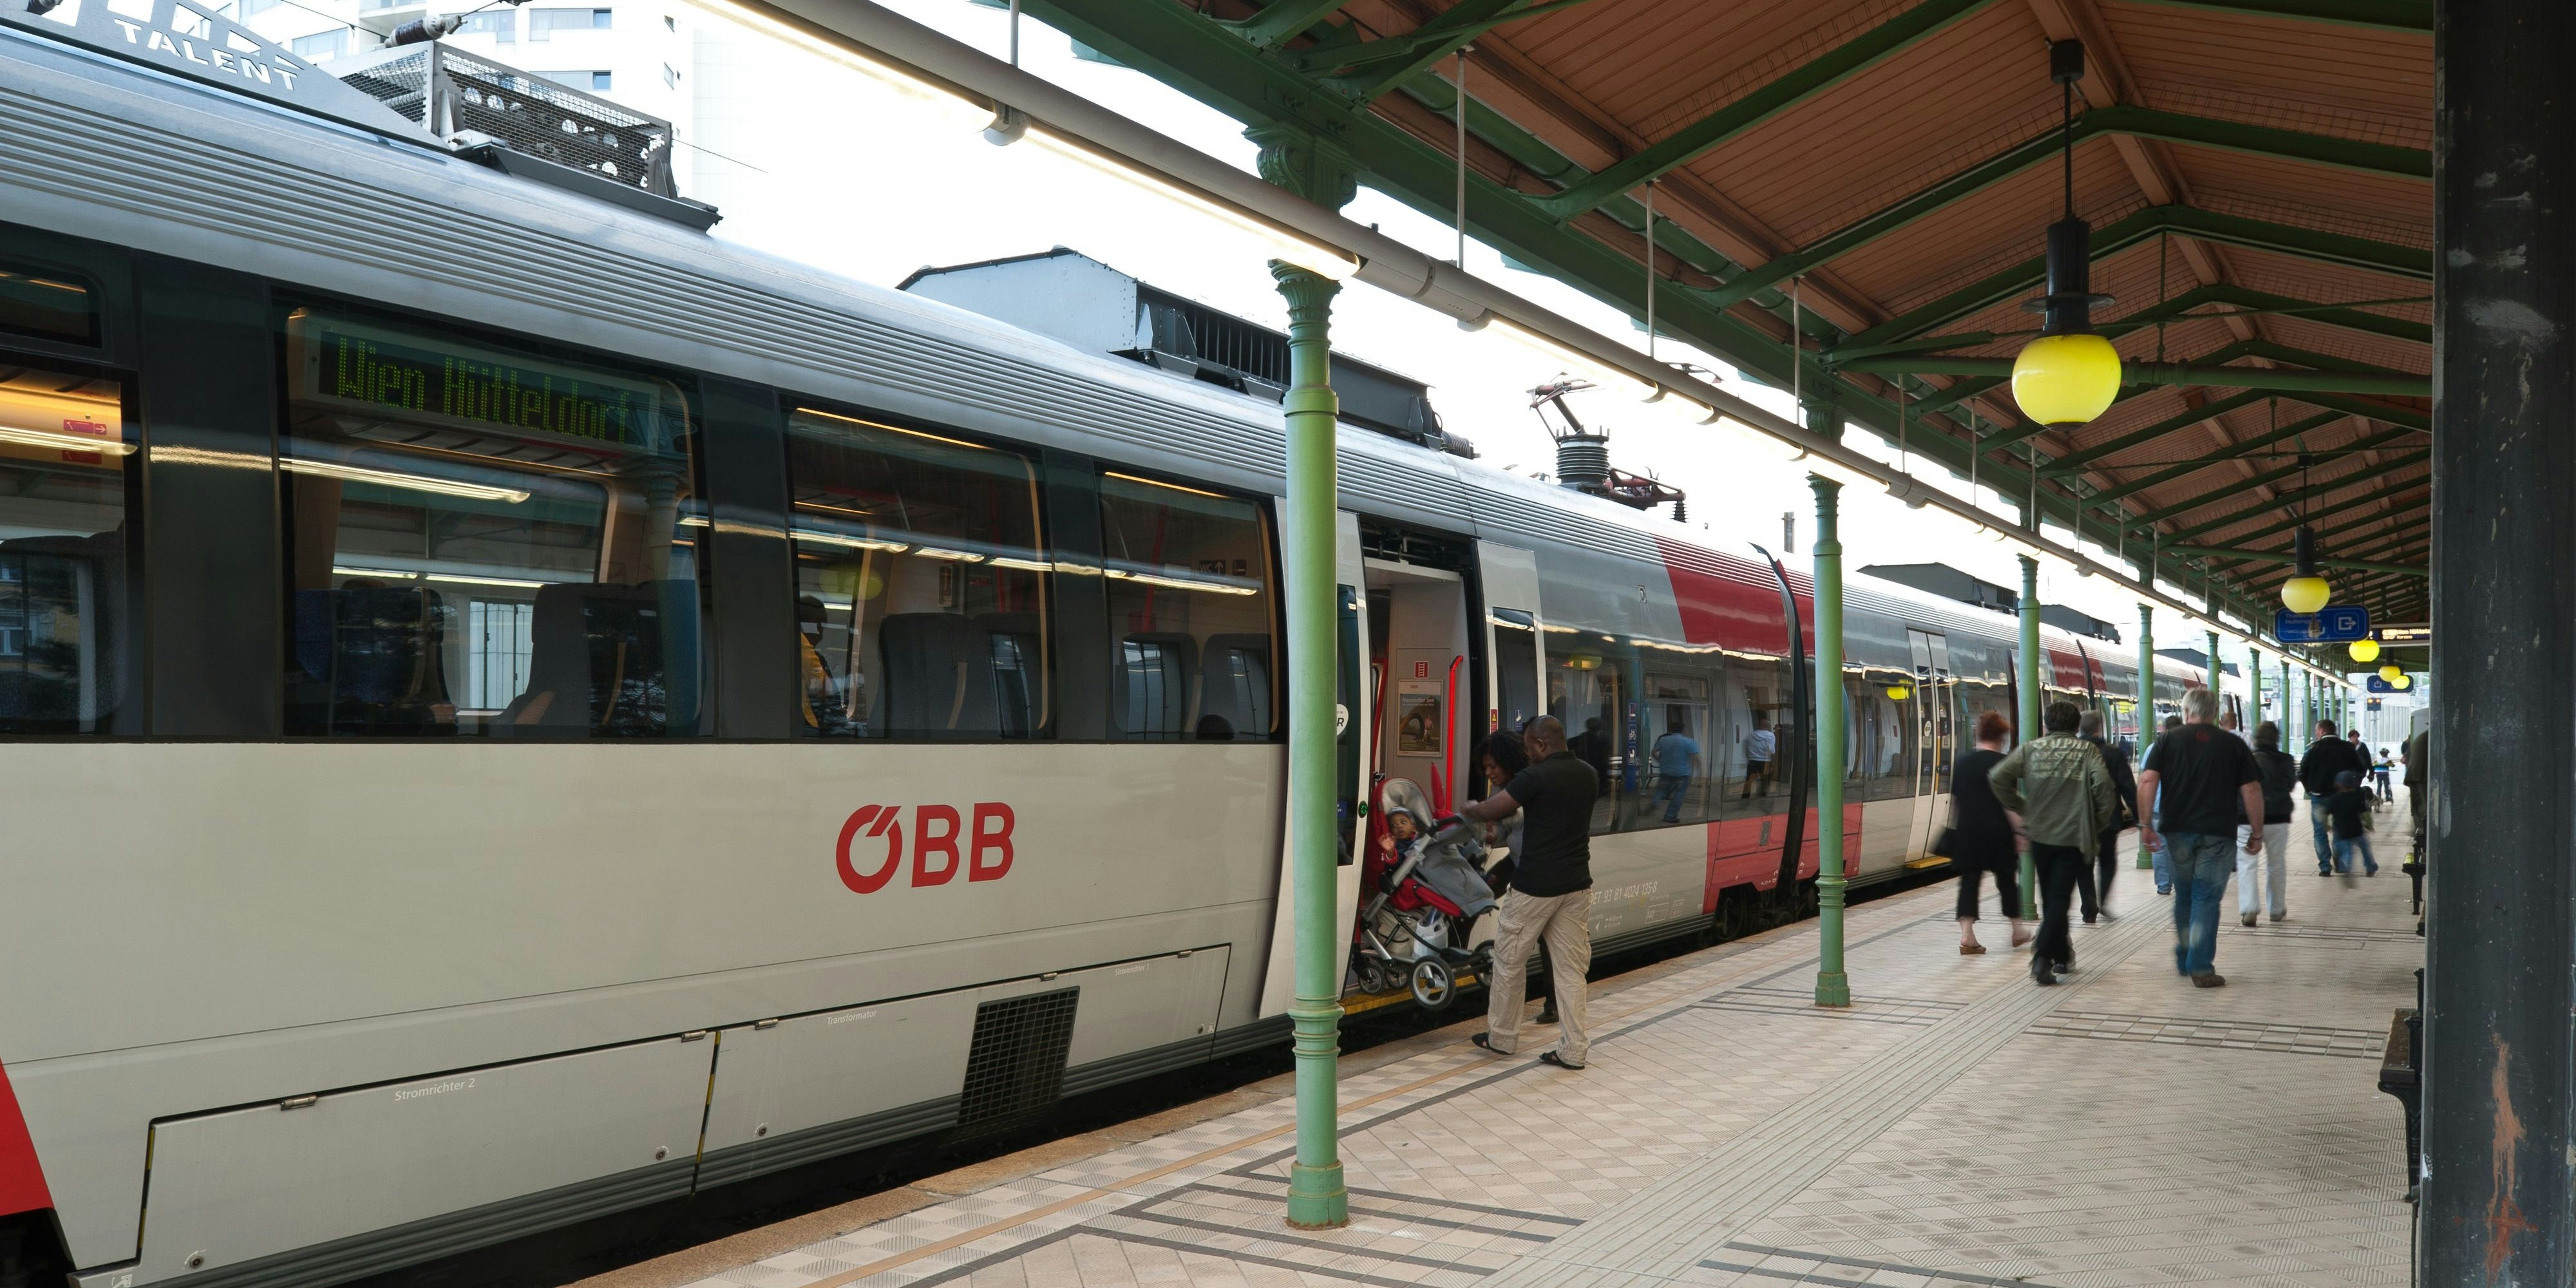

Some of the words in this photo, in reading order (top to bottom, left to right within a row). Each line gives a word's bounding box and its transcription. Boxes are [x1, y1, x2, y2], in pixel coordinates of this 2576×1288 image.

[113, 18, 298, 91] TALENT
[336, 336, 426, 413] Wien
[443, 357, 630, 444] Hütteldorf
[1200, 564, 1211, 573] WC
[835, 802, 1016, 895] ÖBB
[1603, 889, 1613, 903] 93
[1614, 887, 1623, 900] 81
[1624, 884, 1640, 898] 4024
[826, 1010, 878, 1025] Transformator
[395, 1081, 466, 1101] Stromrichter
[468, 1077, 476, 1088] 2
